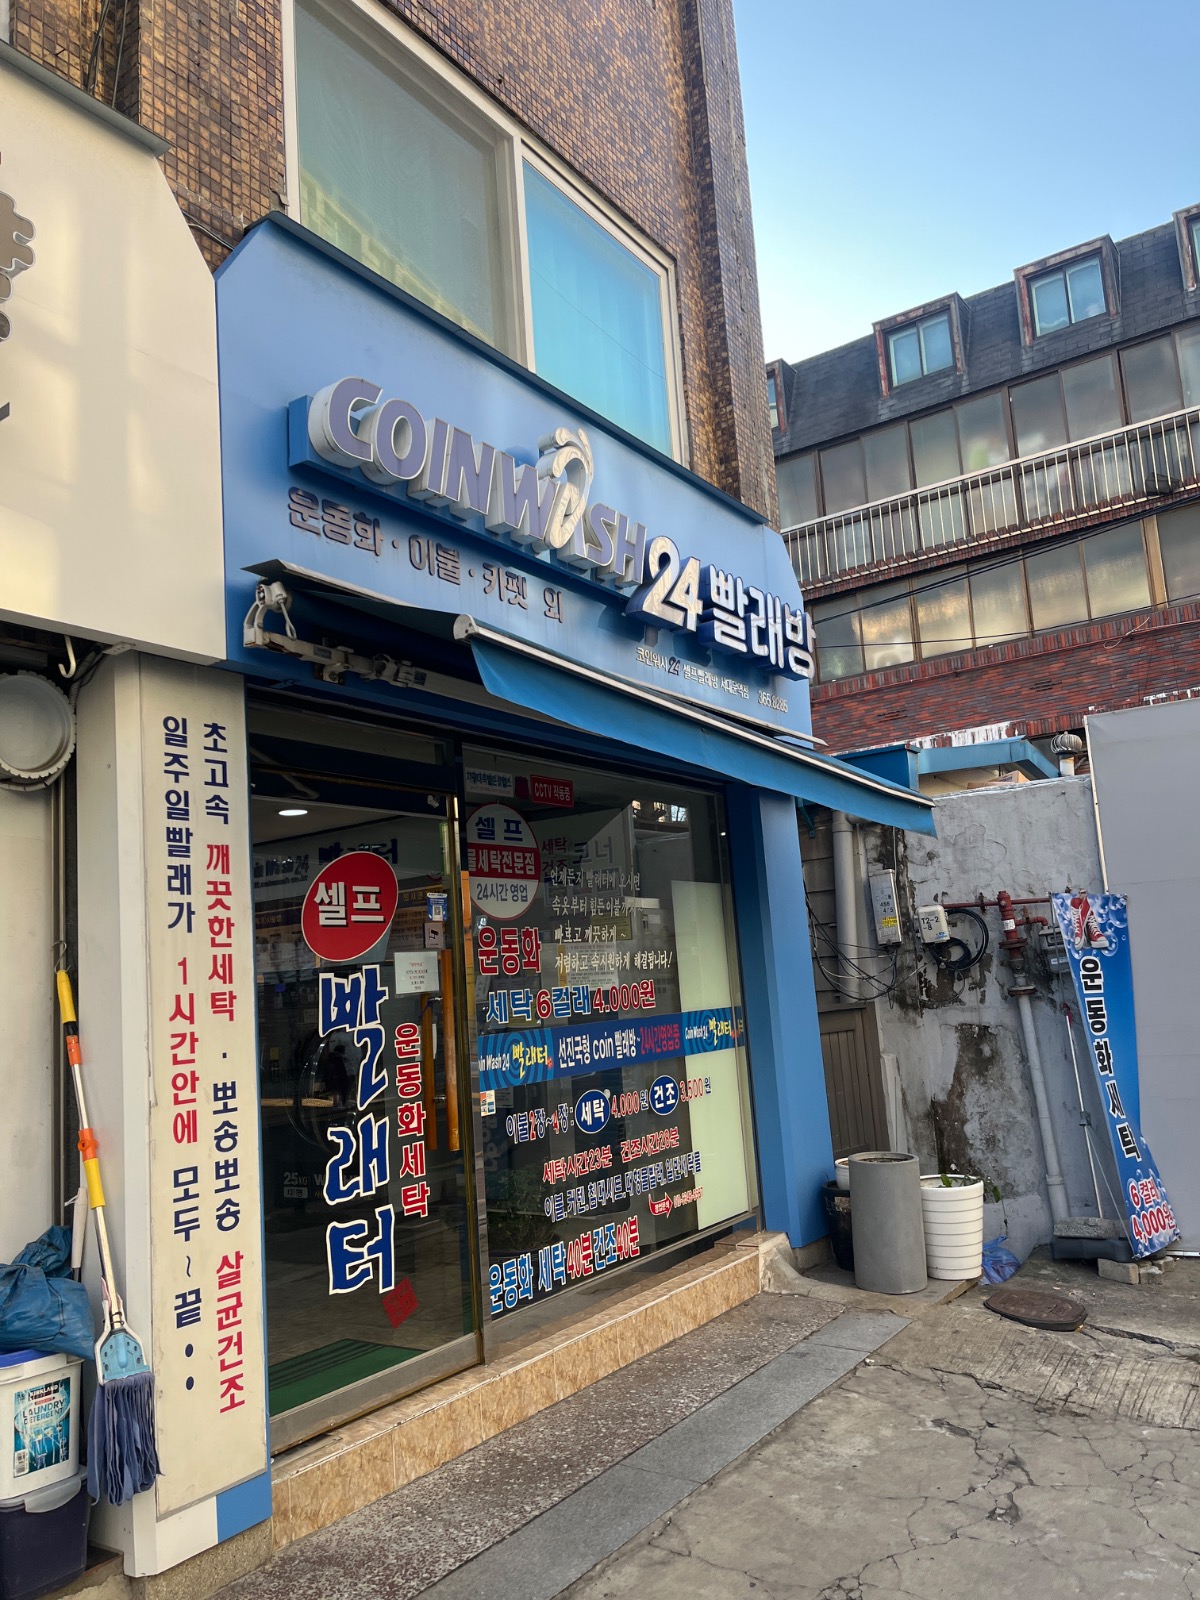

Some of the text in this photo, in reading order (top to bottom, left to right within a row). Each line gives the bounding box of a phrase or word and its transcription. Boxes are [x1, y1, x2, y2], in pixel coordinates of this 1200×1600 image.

[482, 562, 529, 610] 카펫
[543, 586, 564, 624] 외
[708, 563, 817, 681] 빨래방
[682, 664, 719, 690] 셀프빨래방
[203, 722, 230, 825] 초고속
[534, 781, 572, 802] CCTV 작동중
[475, 816, 524, 842] 셀프
[476, 882, 529, 903] 24시간 영업
[550, 866, 585, 889] 언제든지
[313, 881, 386, 927] 셀프
[551, 894, 588, 917] 속옷부터
[478, 926, 543, 976] 운동화
[584, 923, 618, 944] 깨끗하게
[554, 951, 589, 975] 저렴하고
[590, 950, 631, 973] 속시원하게
[486, 987, 533, 1025] 세탁
[512, 1041, 549, 1080] 빨래터
[558, 1033, 591, 1069] 선진국형
[593, 1031, 614, 1060] coin
[394, 1022, 431, 1219] 운동화세탁
[580, 1098, 606, 1127] 세탁
[653, 1082, 679, 1109] 건조
[318, 964, 396, 1296] 빨래터
[212, 1080, 241, 1232] 뽀송뽀송
[489, 1252, 534, 1316] 운동화
[215, 1250, 246, 1415] 살균건조
[22, 1399, 65, 1419] LAUNDRY
